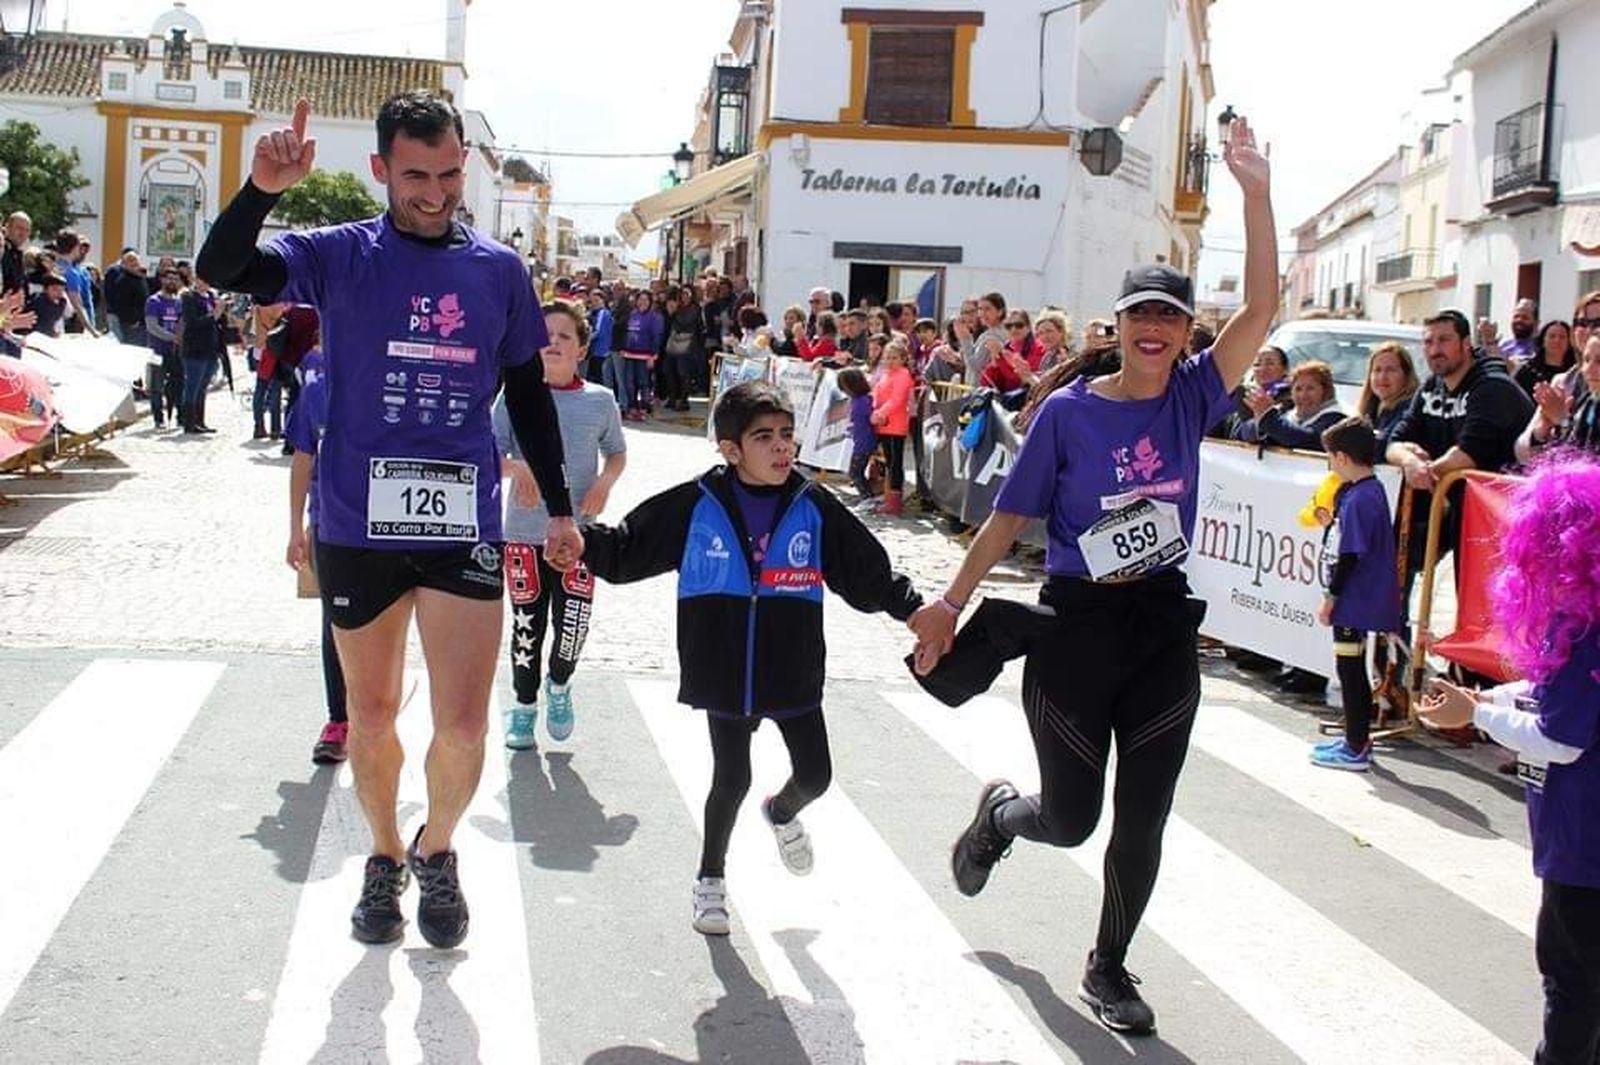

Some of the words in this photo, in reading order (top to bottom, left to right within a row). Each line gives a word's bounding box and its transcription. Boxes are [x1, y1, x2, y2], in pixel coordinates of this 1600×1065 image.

[800, 168, 897, 193] Taberna
[904, 172, 936, 195] la
[941, 173, 1041, 200] Tertulia
[374, 461, 387, 478] 6
[400, 487, 446, 517] 126
[375, 523, 390, 534] Yo
[392, 523, 421, 534] Corro
[1112, 521, 1159, 560] 859
